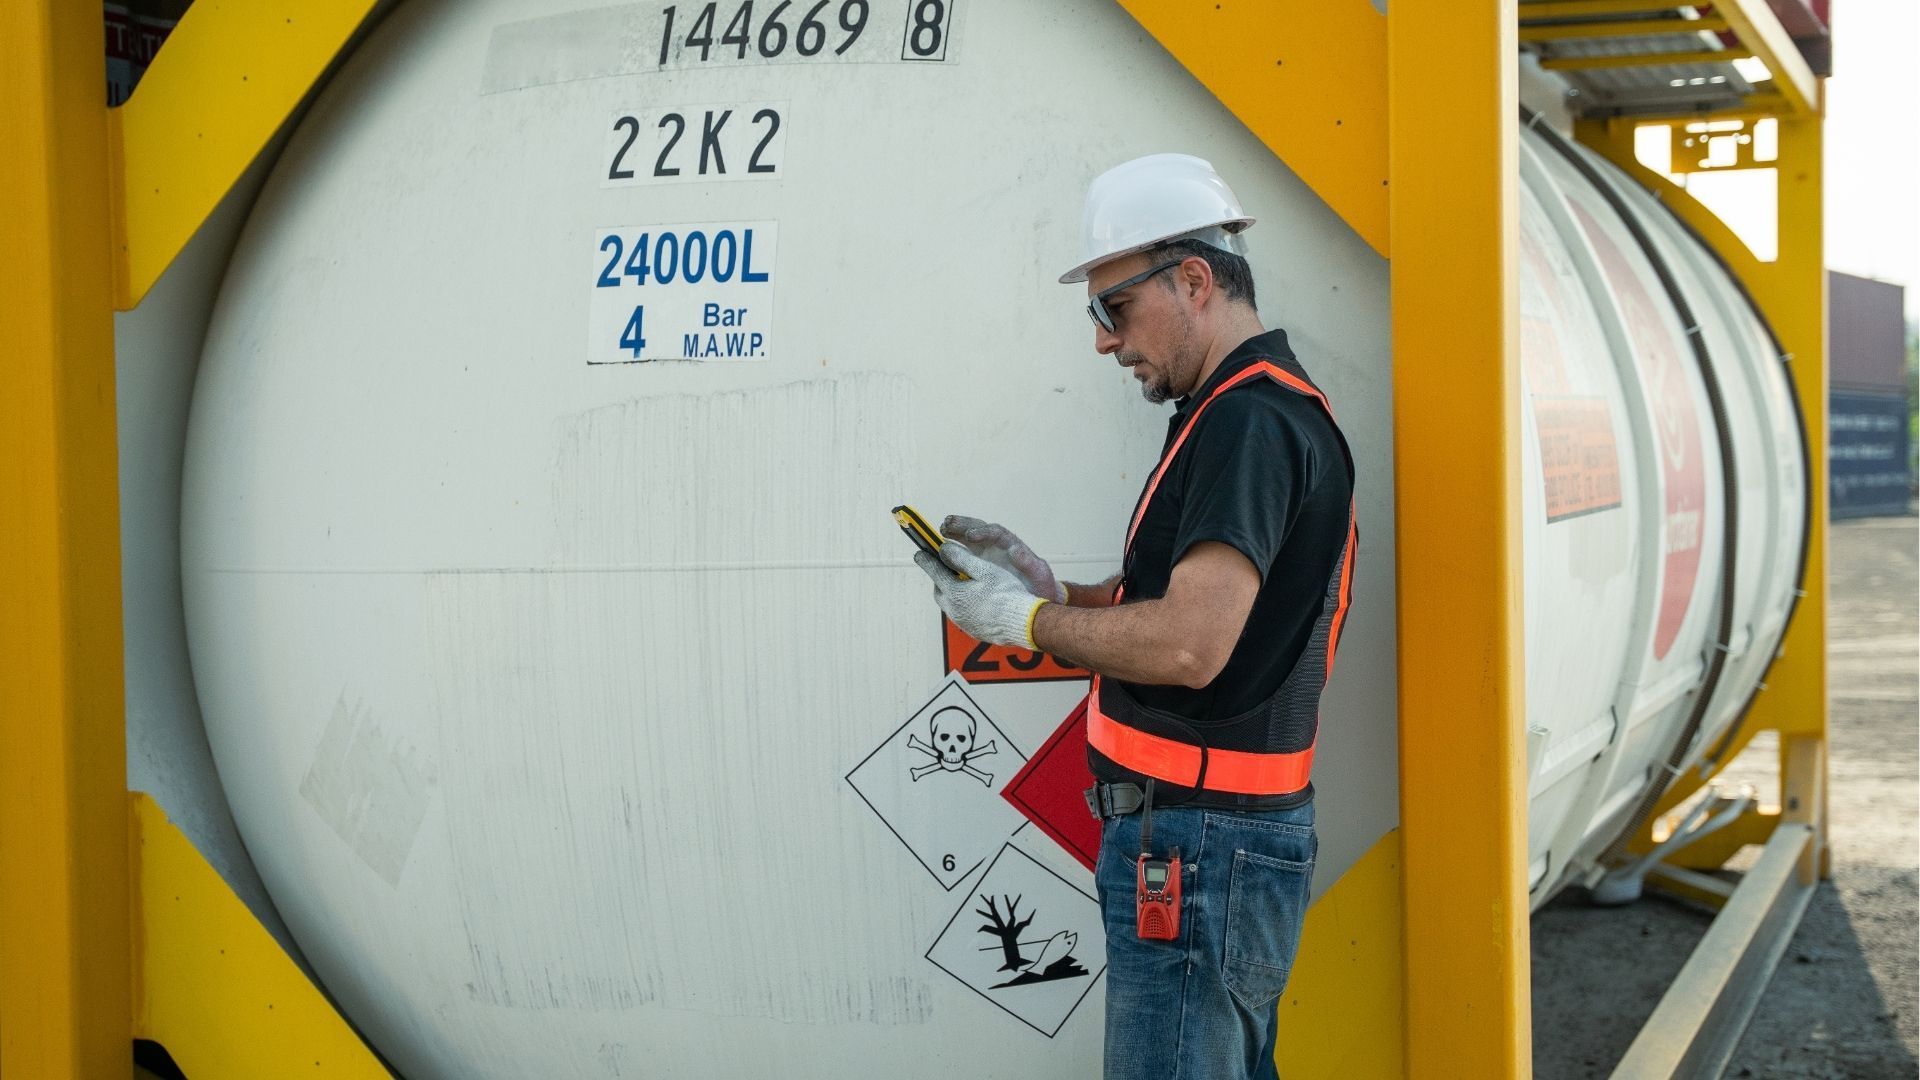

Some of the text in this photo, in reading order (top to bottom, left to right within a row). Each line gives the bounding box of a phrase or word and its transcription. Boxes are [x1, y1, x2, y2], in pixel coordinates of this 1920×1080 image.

[659, 0, 945, 64] 144669 8
[608, 109, 781, 179] 22K2
[596, 229, 769, 287] 24000L
[619, 303, 748, 358] 4 Bar
[683, 333, 766, 358] M.A.W.P.
[942, 853, 956, 872] 6
